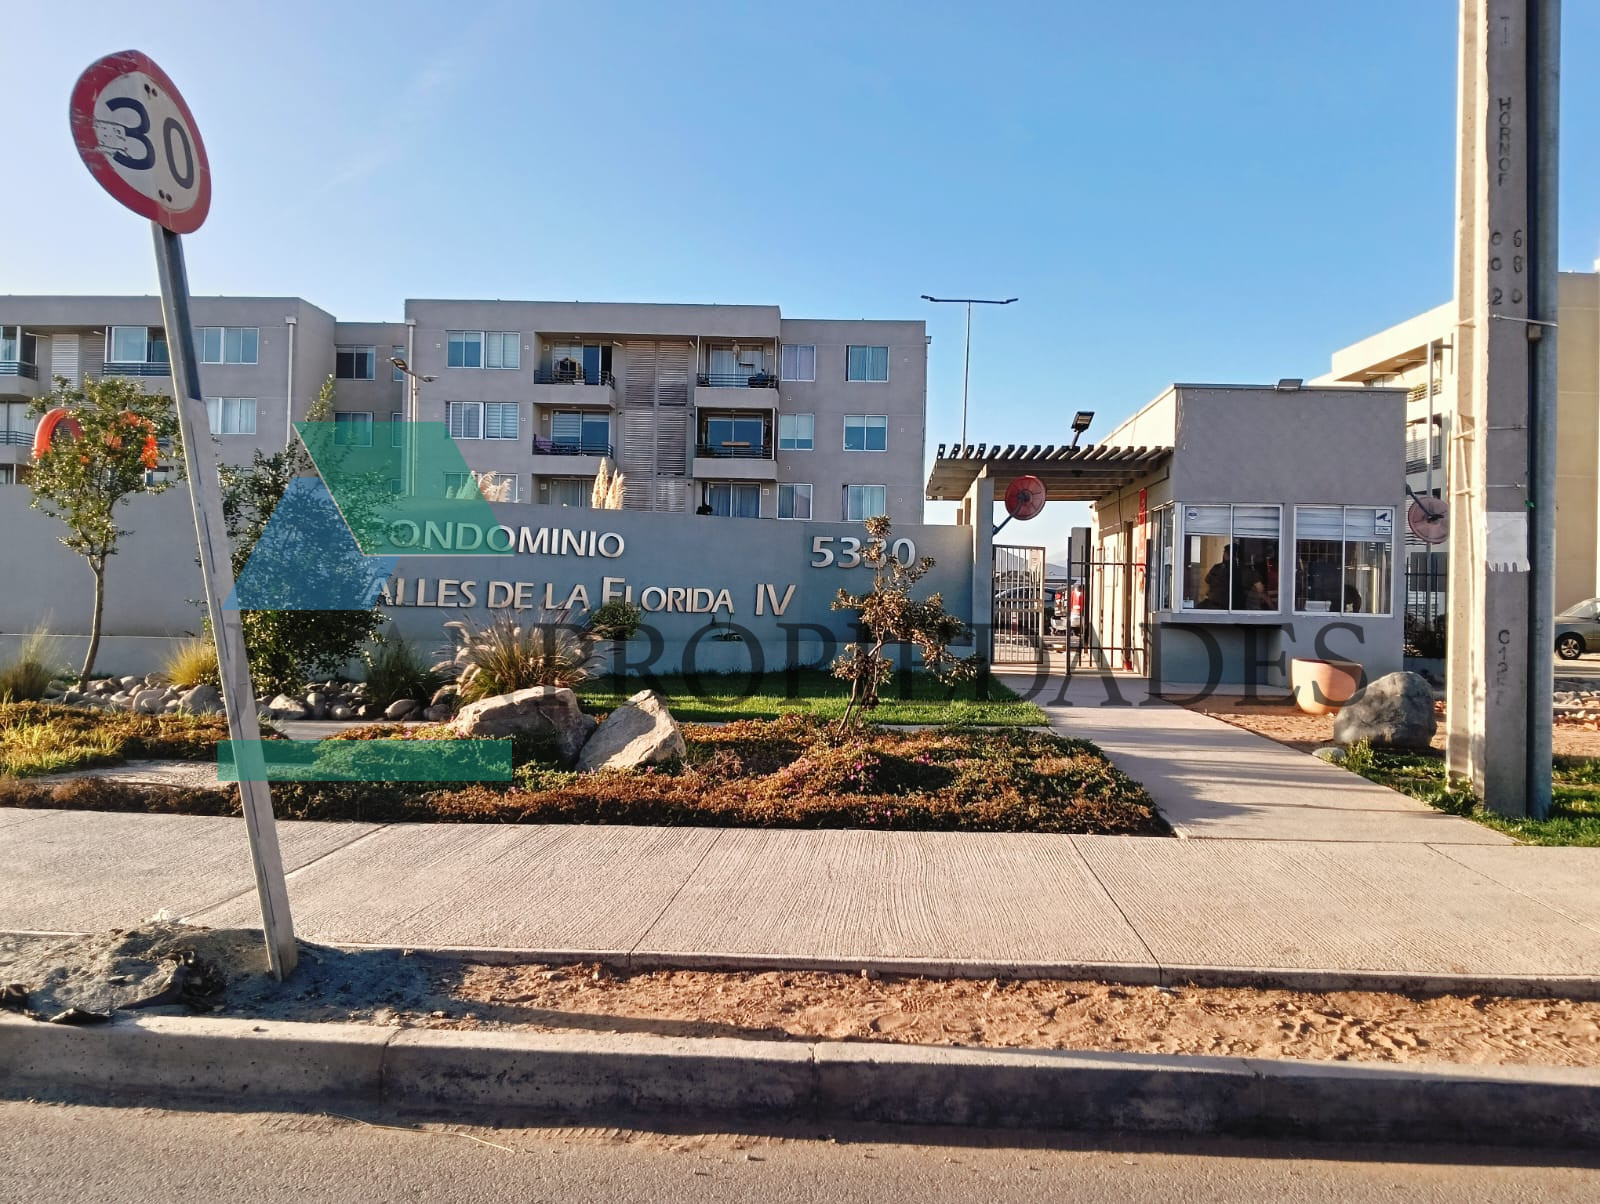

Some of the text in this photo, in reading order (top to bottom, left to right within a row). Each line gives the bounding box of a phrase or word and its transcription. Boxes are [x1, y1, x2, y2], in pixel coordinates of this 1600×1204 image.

[105, 97, 195, 189] 30
[811, 536, 916, 568] 5330
[487, 580, 535, 609] DE
[545, 582, 591, 611] LA
[602, 576, 735, 614] FLORIDA
[755, 583, 796, 616] IV
